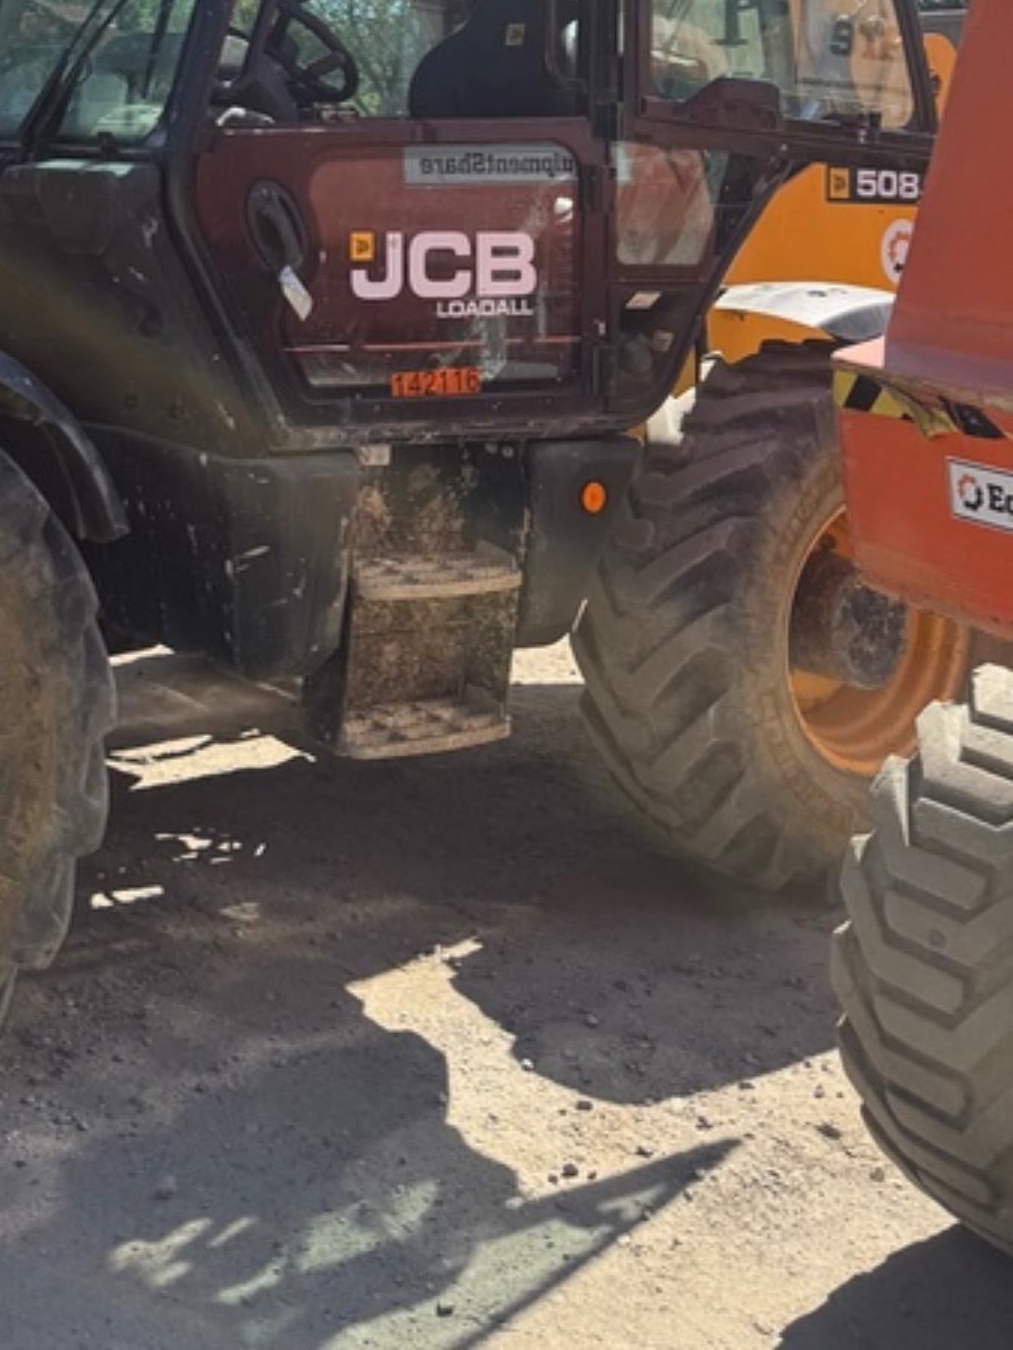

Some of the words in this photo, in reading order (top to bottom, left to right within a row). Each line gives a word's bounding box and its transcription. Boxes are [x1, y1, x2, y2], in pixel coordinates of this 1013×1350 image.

[856, 169, 919, 199] 508
[350, 231, 537, 300] JCB
[436, 299, 534, 318] LOADALL
[393, 369, 479, 397] 142116
